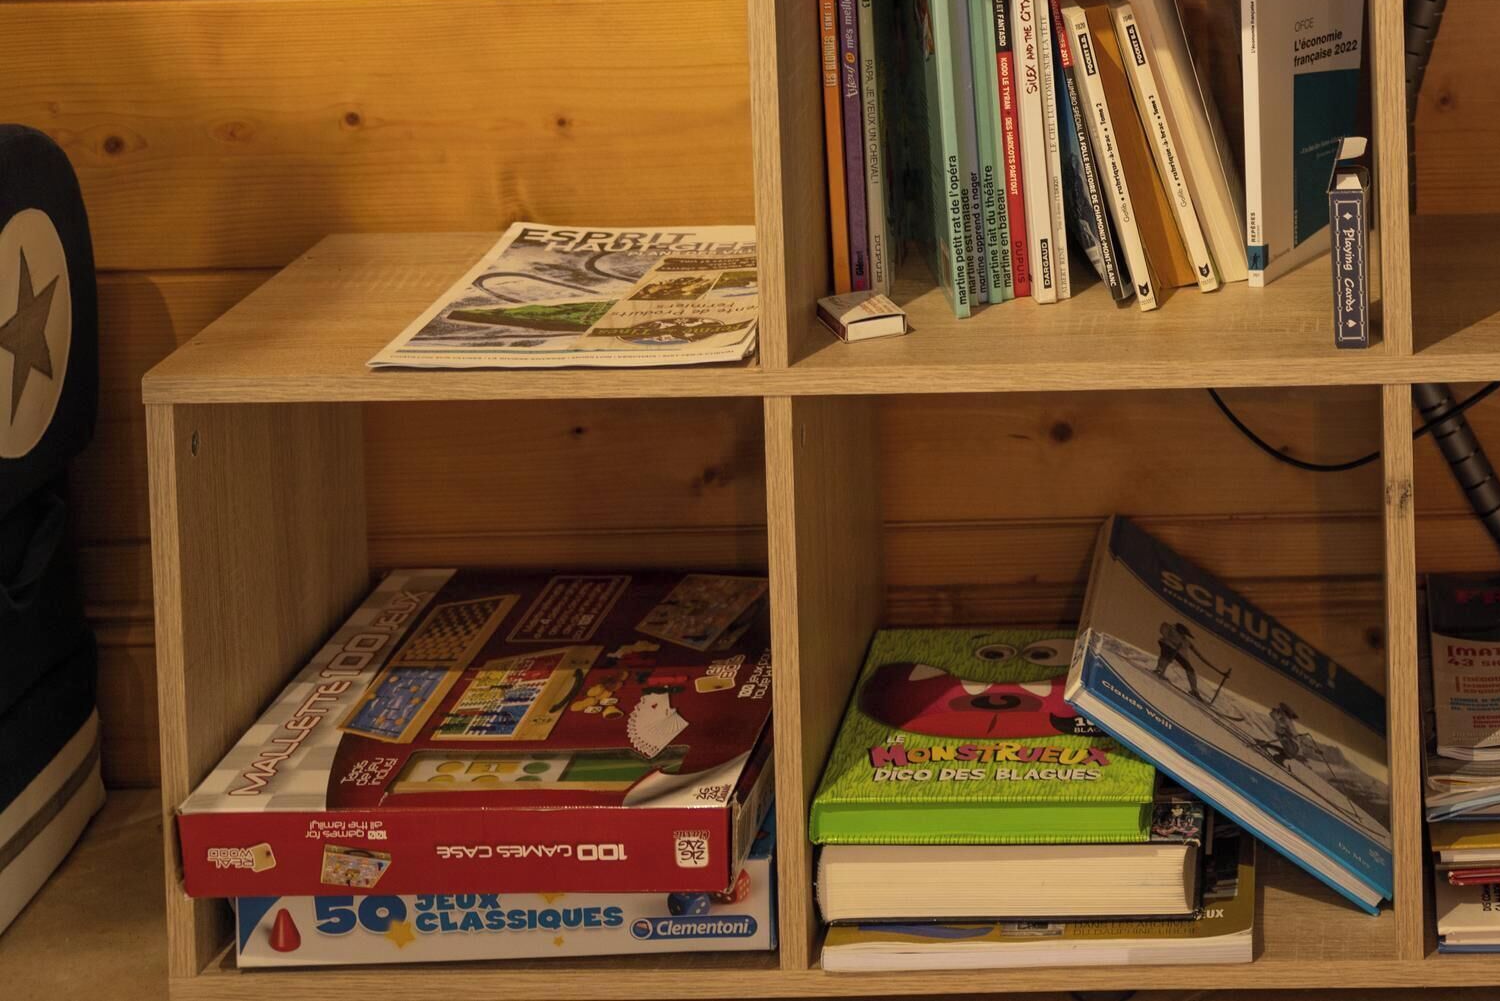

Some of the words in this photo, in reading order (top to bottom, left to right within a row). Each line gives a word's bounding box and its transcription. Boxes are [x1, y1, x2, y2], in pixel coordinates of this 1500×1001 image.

[996, 4, 1003, 12] ET
[997, 14, 1006, 47] FANTASIO
[1294, 17, 1315, 32] OFCE
[1131, 40, 1145, 64] POCKET
[1294, 29, 1343, 52] L'économie
[1060, 49, 1070, 66] 2011
[1083, 50, 1095, 74] POCKET
[1294, 47, 1332, 68] française
[1334, 40, 1358, 56] 2022
[866, 87, 874, 98] JE
[1002, 78, 1010, 86] LE
[868, 100, 876, 126] VEUX
[1005, 117, 1013, 131] DES
[869, 128, 877, 142] UN
[1079, 132, 1087, 142] LA
[1006, 132, 1016, 164] HARICOTS
[1080, 142, 1092, 162] FOLLE
[947, 155, 960, 194] l'opéra
[984, 164, 996, 208] théâtre
[1008, 164, 1018, 194] PARTOUT
[1085, 162, 1100, 194] HISTOIRE
[970, 172, 980, 202] nager
[951, 200, 960, 214] de
[961, 188, 972, 232] malade
[998, 188, 1008, 229] bateau
[1092, 194, 1100, 204] DE
[952, 218, 961, 234] rat
[986, 210, 996, 226] du
[512, 228, 696, 244] ESPRIT
[972, 212, 985, 254] apprend
[988, 228, 998, 248] fait
[1001, 232, 1008, 247] en
[953, 236, 965, 262] petit
[1094, 204, 1117, 287] CHAMONIX-MONT-BLANC
[1342, 227, 1355, 271] Playing
[989, 250, 1000, 288] martine
[1000, 250, 1012, 288] martine
[1015, 240, 1026, 284] DUPUIS
[1041, 240, 1051, 287] DARGAUD
[955, 266, 967, 304] martine
[965, 256, 976, 294] martine
[976, 256, 986, 294] martine
[1344, 278, 1355, 313] Cards
[1161, 571, 1317, 674] SCHUSS
[1448, 658, 1474, 668] 43
[228, 680, 352, 796] MALLETTE
[320, 632, 391, 680] 100
[373, 590, 431, 632] JEUX
[1102, 680, 1143, 710] Claude
[1145, 708, 1174, 730] Weill
[886, 736, 906, 744] LE
[870, 742, 1111, 768] MONSTRUEUX
[938, 768, 986, 782] DES
[994, 768, 1102, 782] BLAGUES
[306, 831, 320, 839] for
[322, 830, 364, 839] games
[345, 821, 364, 830] the
[367, 830, 388, 840] 100
[369, 822, 383, 830] all
[208, 848, 256, 860] WOOD
[436, 846, 492, 858] CASE
[496, 844, 572, 859] GAMES
[576, 842, 627, 860] 100
[213, 859, 254, 869] REAL
[414, 894, 502, 912] JEUX
[314, 896, 408, 935] 50
[414, 906, 624, 933] CLASSIQUES
[656, 917, 749, 937] Clementoni
